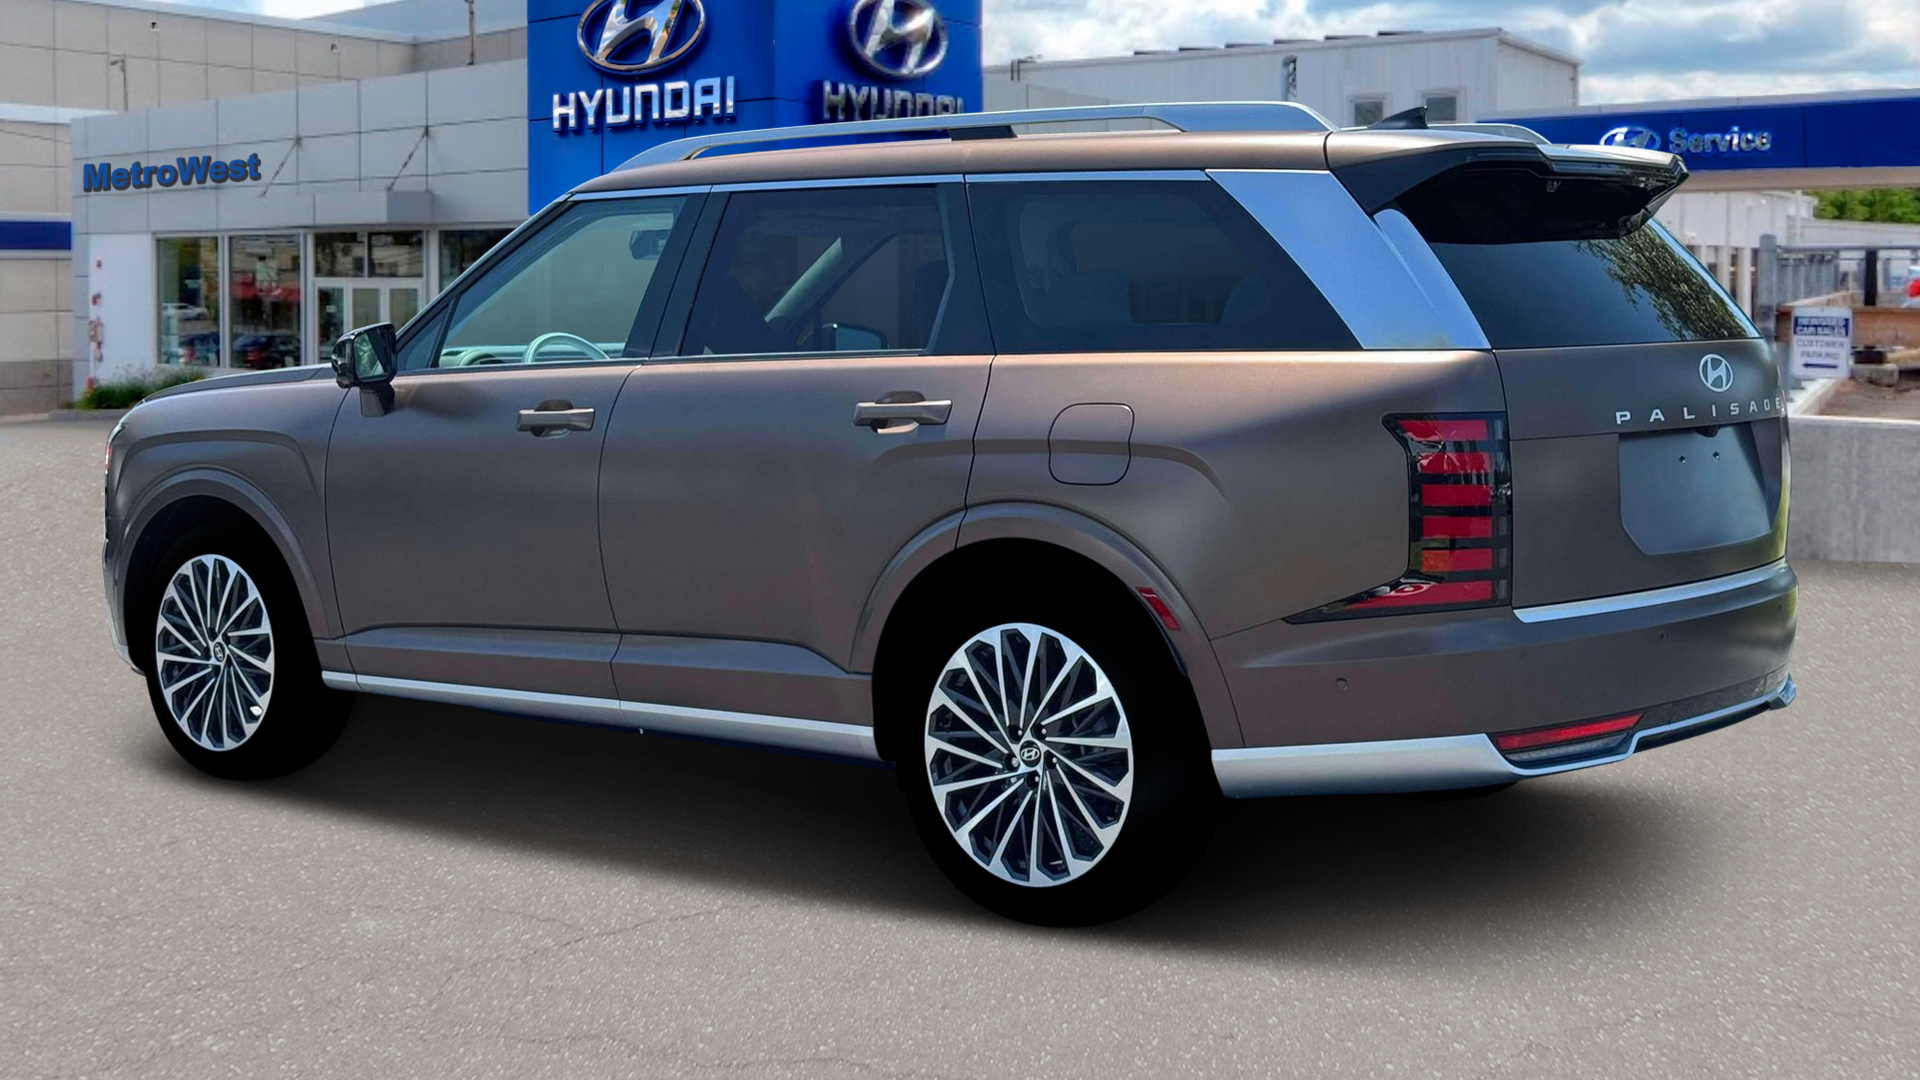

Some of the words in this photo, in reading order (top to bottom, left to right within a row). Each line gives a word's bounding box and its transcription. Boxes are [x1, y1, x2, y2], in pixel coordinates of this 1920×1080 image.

[553, 76, 735, 130] HYUNDAI
[1669, 126, 1772, 153] Service
[83, 153, 261, 192] MetroWest
[1796, 339, 1844, 348] CUSTOMER
[1801, 350, 1840, 360] PARKING
[1615, 397, 1782, 425] PALISADE
